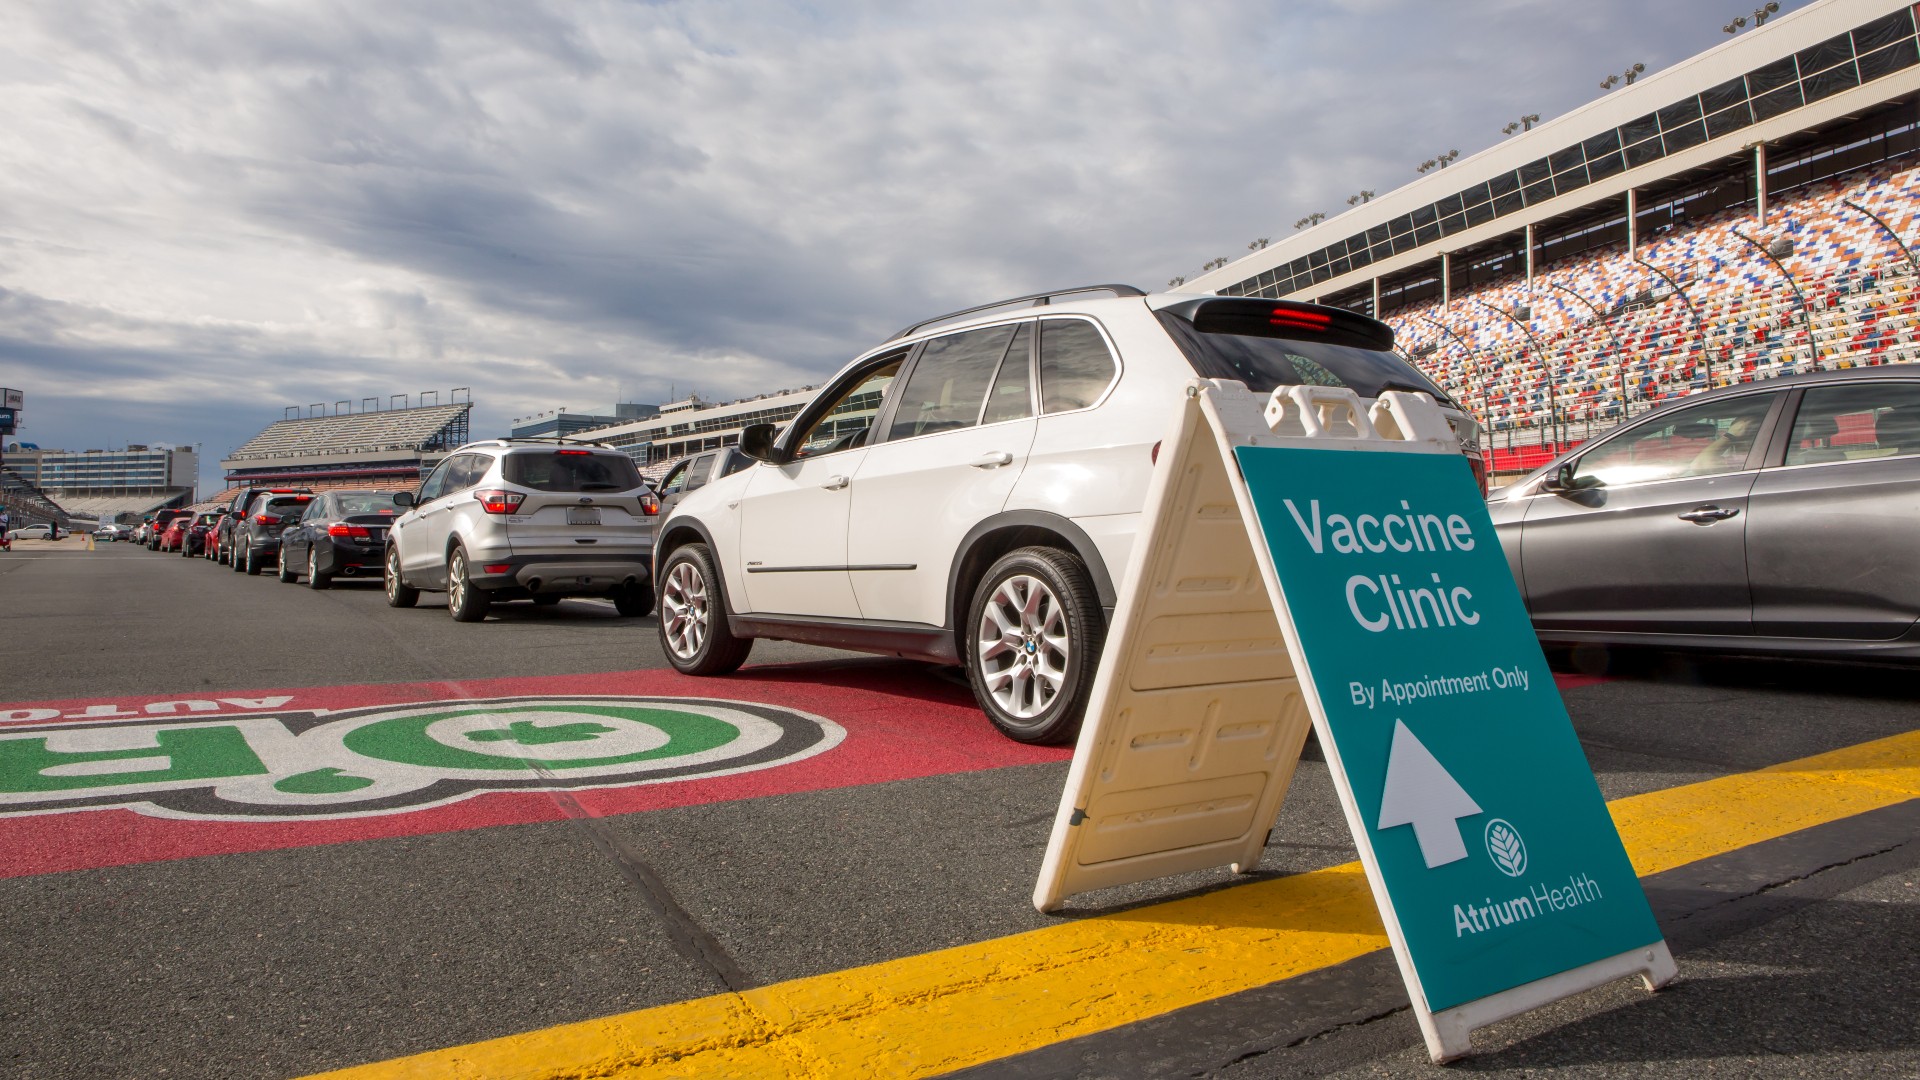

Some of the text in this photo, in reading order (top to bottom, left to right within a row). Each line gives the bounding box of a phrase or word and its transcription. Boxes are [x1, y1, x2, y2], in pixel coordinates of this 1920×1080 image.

[1283, 499, 1475, 554] Vaccine
[1345, 572, 1481, 633] Clinic
[0, 696, 294, 721] AUTO
[1349, 665, 1529, 709] By Appointment Only
[1453, 872, 1603, 938] Atrium Health
